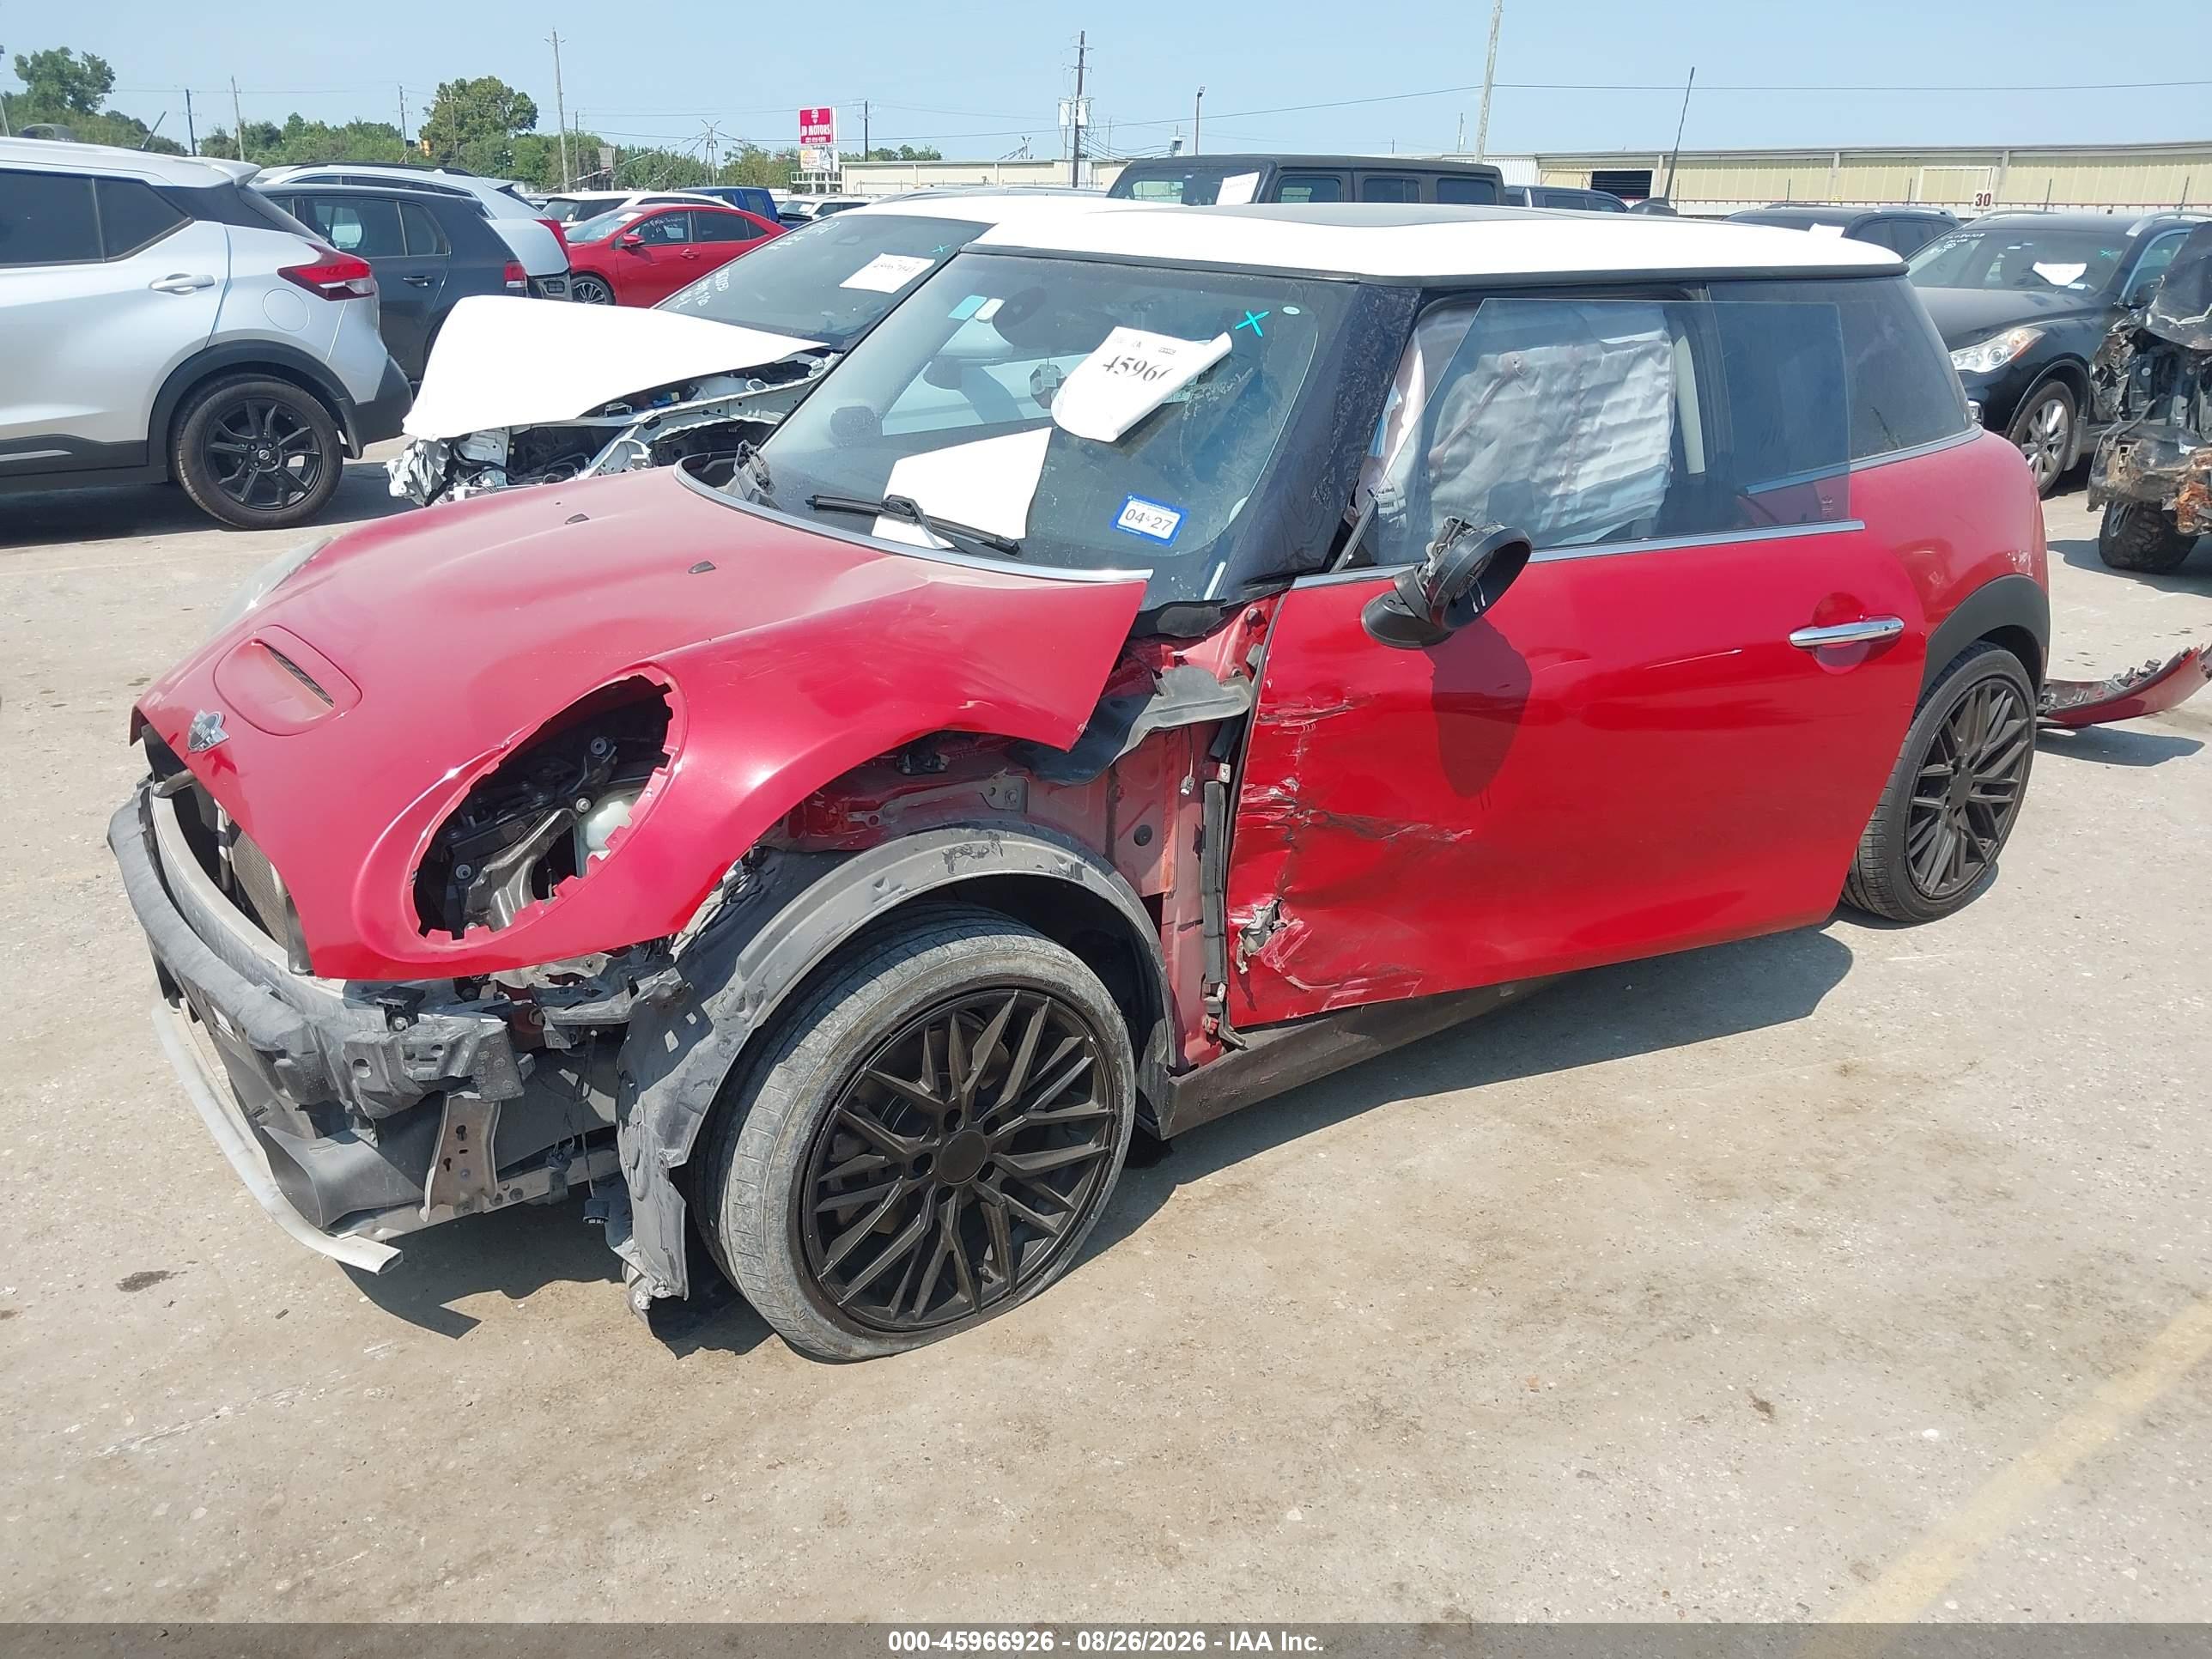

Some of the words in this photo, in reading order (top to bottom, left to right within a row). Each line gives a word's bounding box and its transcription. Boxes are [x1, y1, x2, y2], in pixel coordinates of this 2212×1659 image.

[809, 125, 830, 136] MOTORS
[1975, 193, 1991, 206] 30
[1151, 516, 1174, 531] 27
